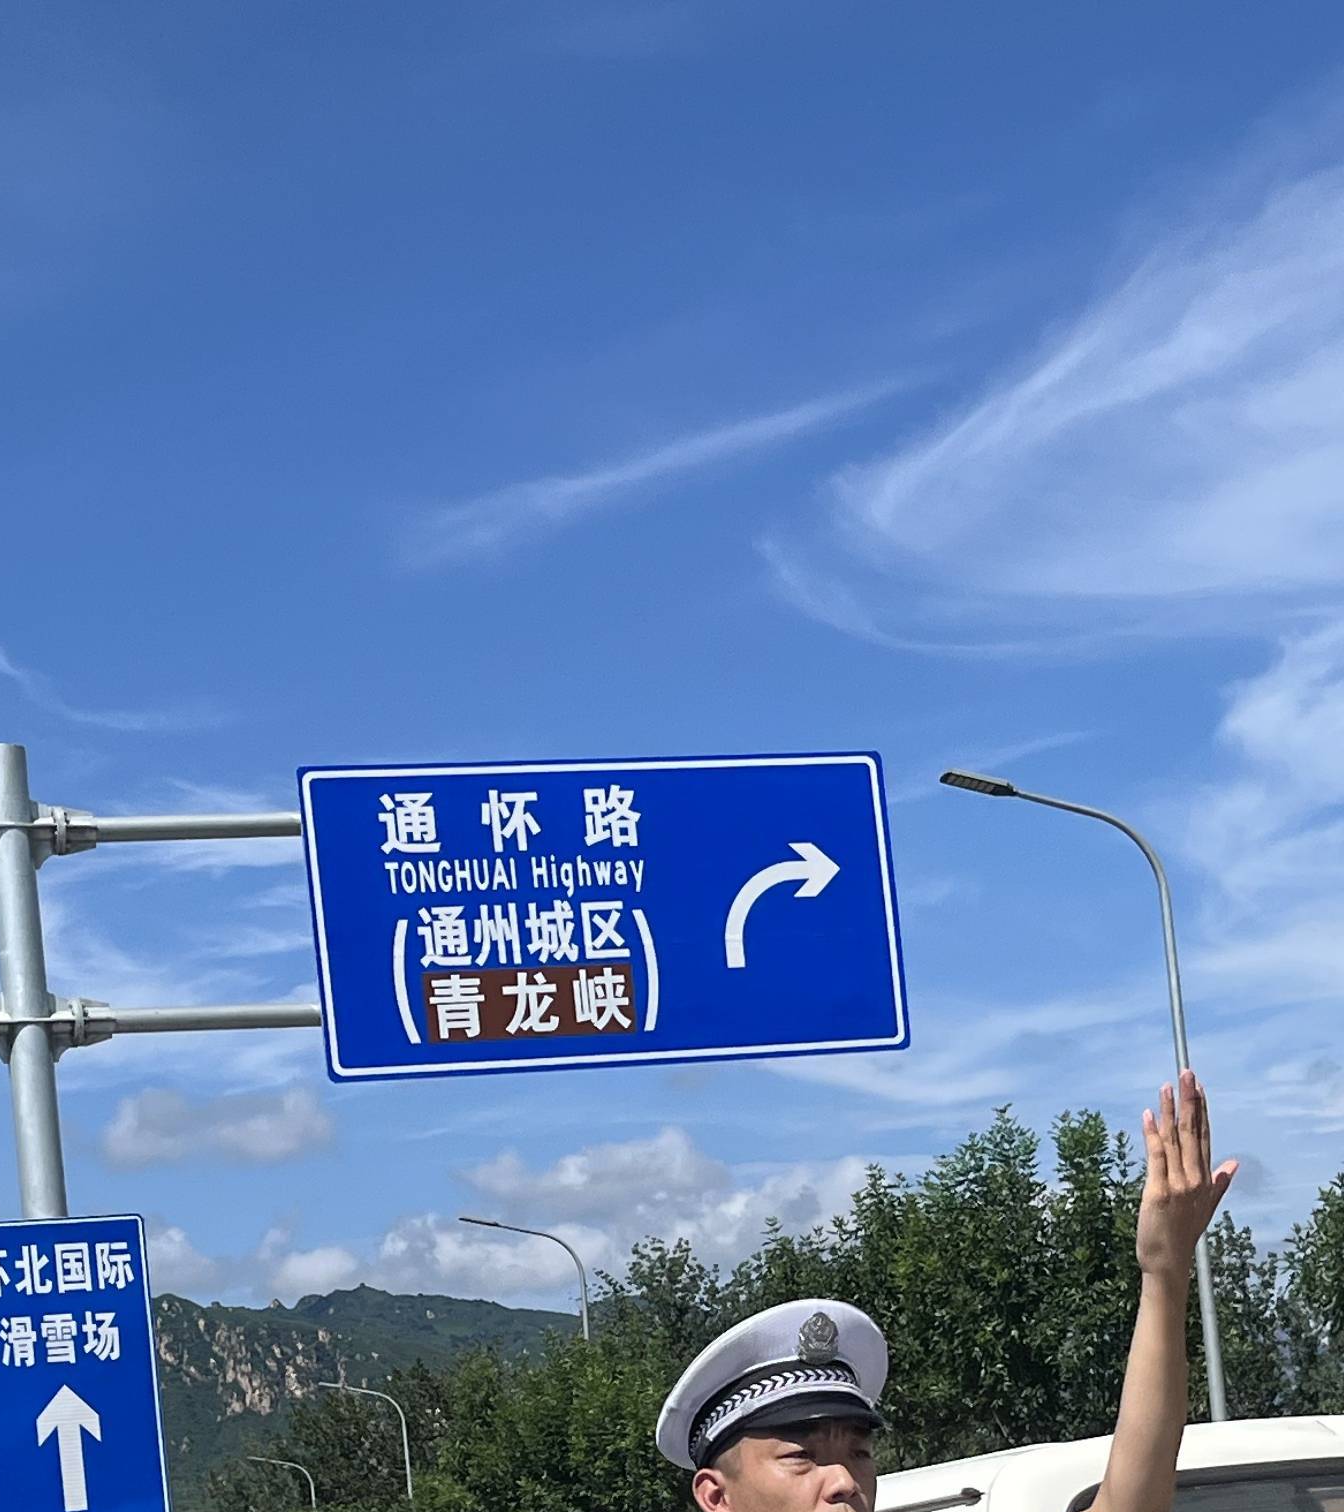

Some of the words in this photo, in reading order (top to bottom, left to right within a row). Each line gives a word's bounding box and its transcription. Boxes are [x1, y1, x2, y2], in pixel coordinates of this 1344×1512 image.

[378, 785, 642, 856] 通怀路
[384, 858, 517, 895] TONGHUAI
[532, 855, 644, 897] Highway
[429, 969, 632, 1039] 青龙峡
[0, 1311, 121, 1367] 滑雪场
